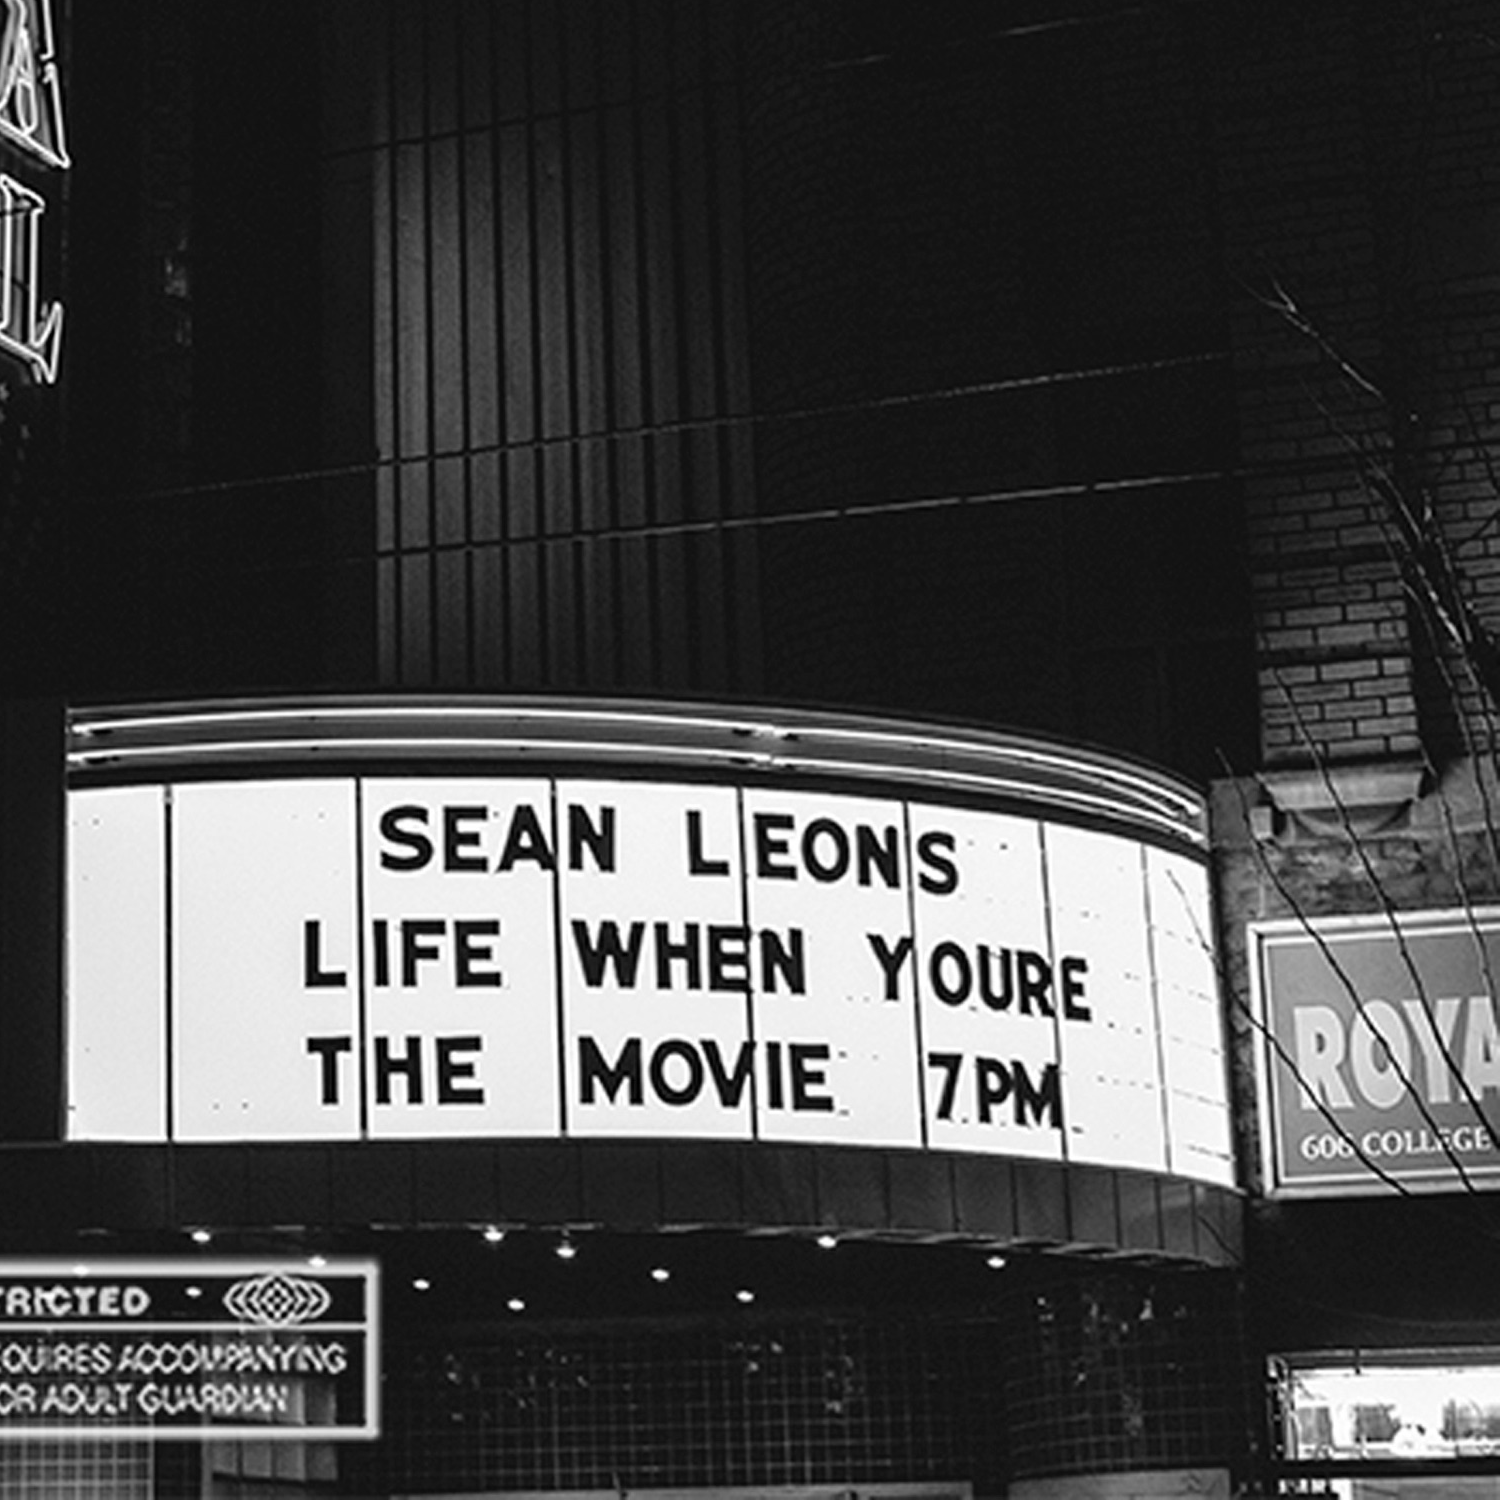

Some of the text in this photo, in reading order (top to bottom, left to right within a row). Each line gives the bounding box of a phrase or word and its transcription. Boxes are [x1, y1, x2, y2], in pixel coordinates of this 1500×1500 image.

[379, 804, 960, 896] SEAN LEONS
[303, 919, 1094, 1023] LIFE WHEN YOURE
[307, 1036, 1065, 1130] THE MOVIE 7PM
[1361, 1126, 1493, 1157] COLLEGE
